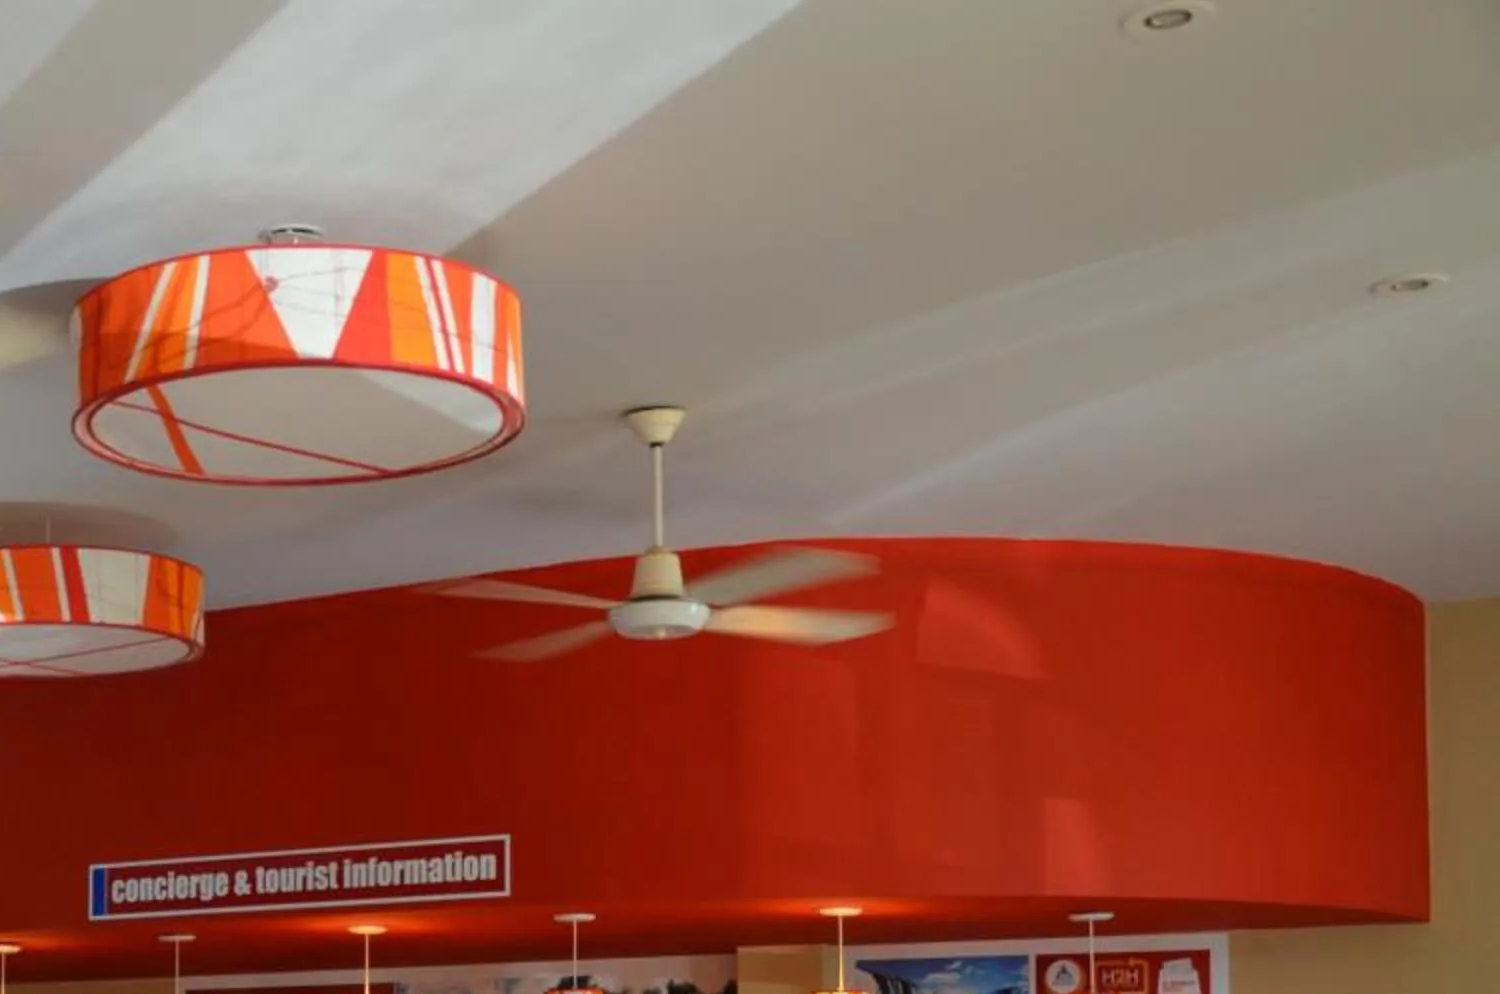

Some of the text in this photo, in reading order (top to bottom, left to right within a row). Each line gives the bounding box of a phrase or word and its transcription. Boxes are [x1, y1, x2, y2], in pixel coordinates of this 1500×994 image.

[111, 852, 497, 903] concierge & tourist information
